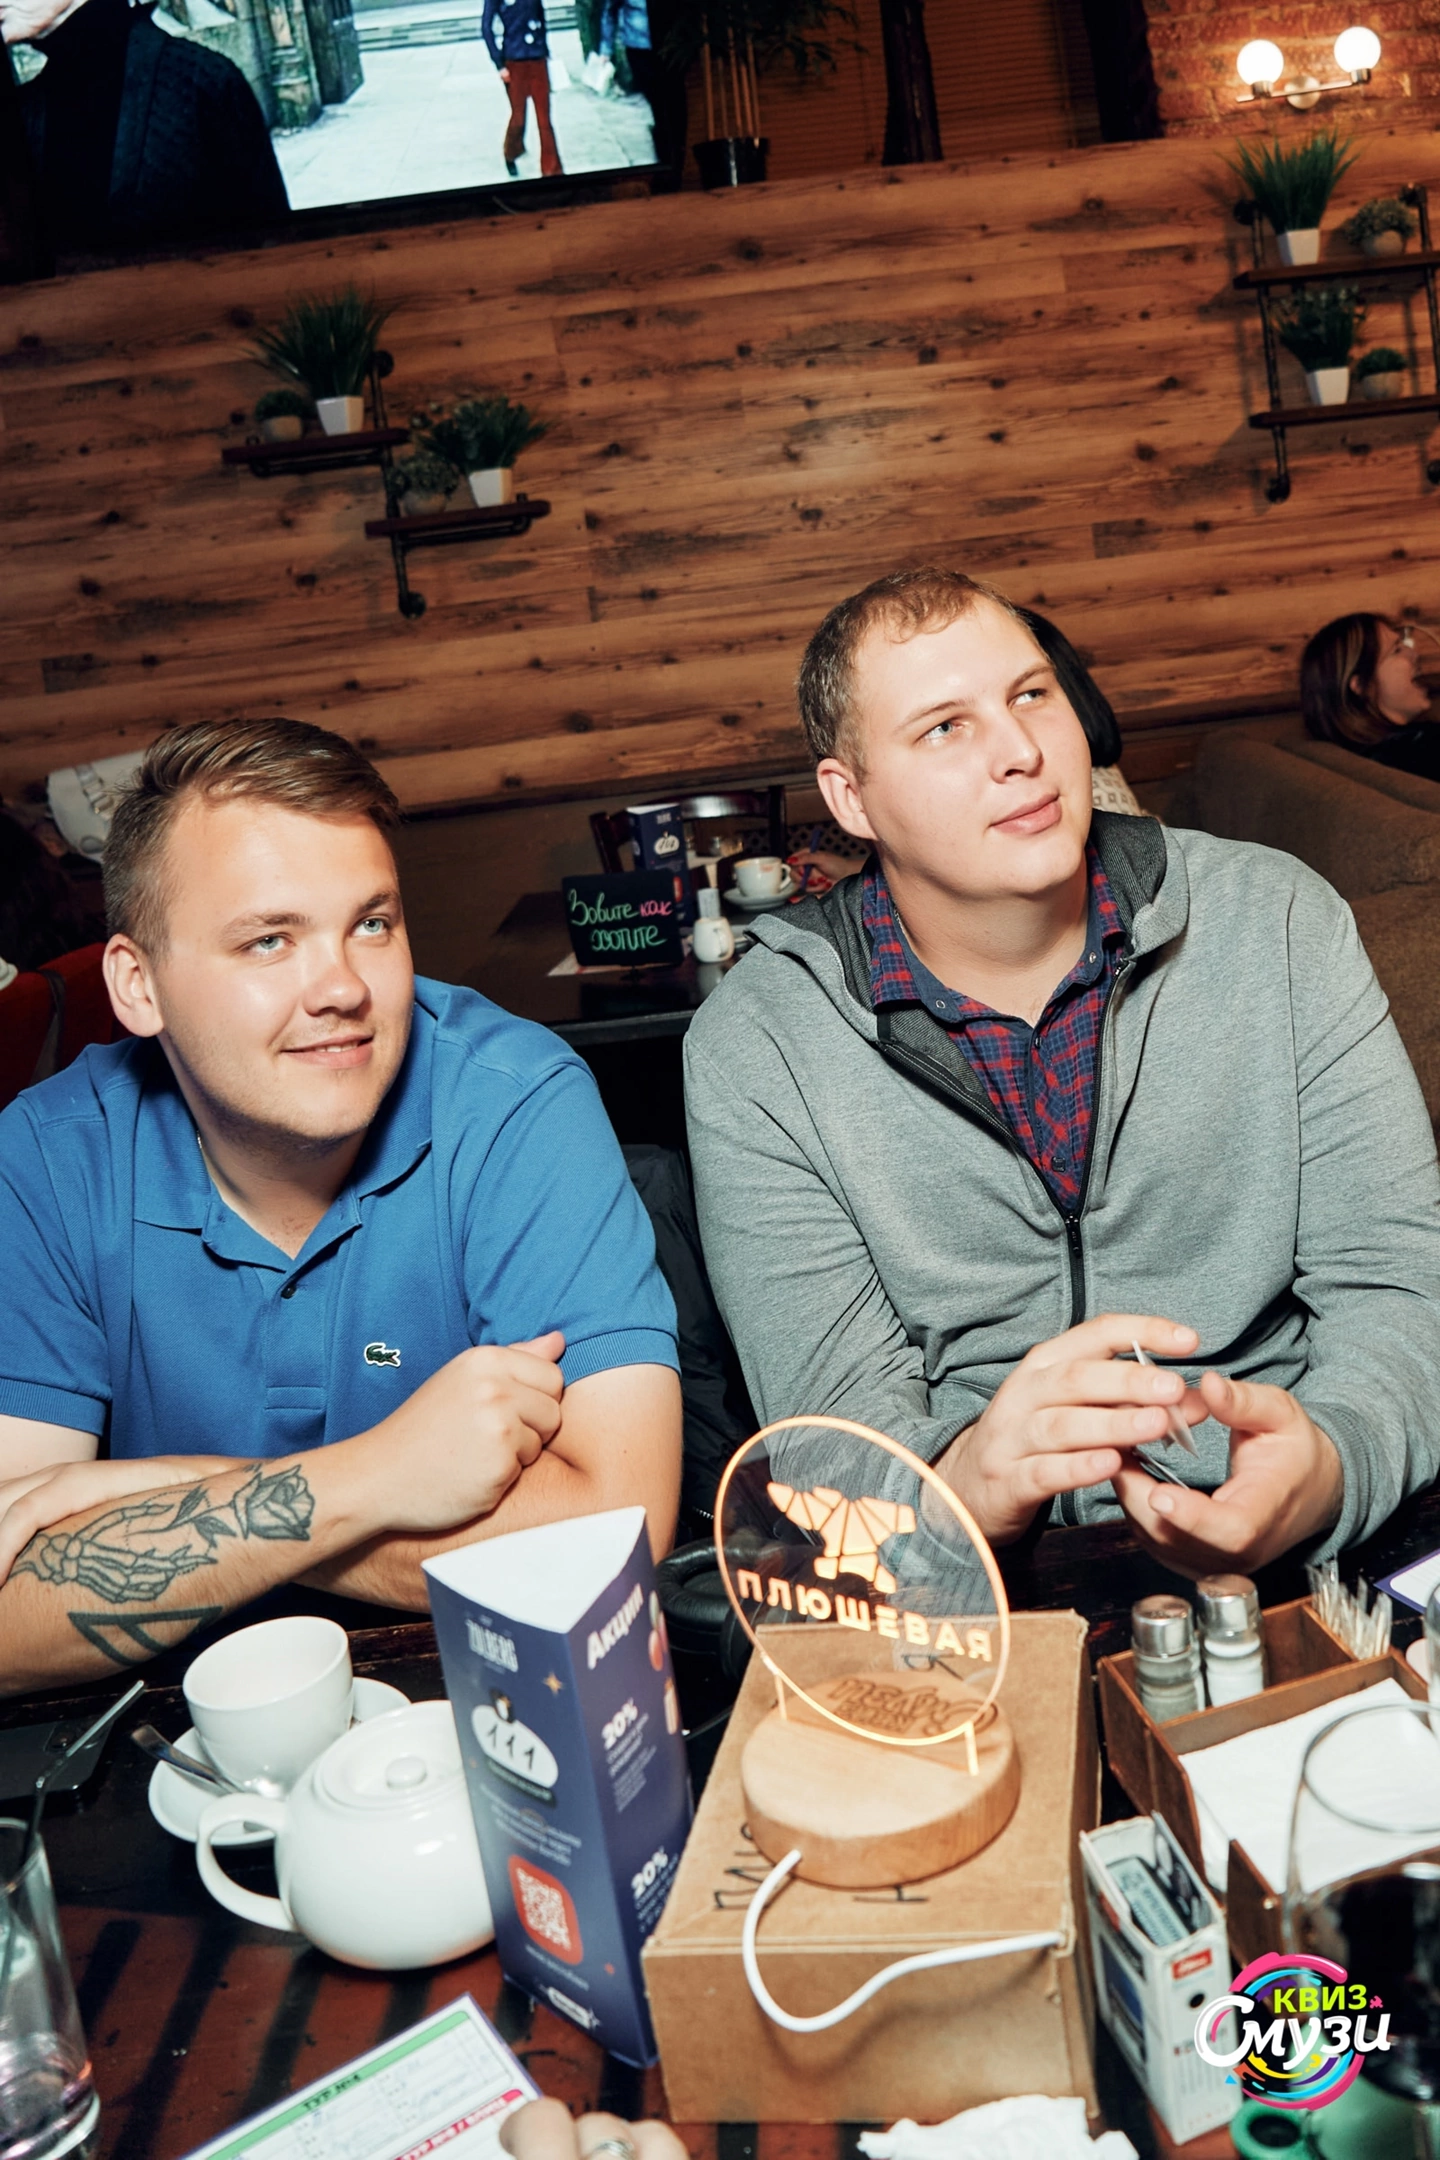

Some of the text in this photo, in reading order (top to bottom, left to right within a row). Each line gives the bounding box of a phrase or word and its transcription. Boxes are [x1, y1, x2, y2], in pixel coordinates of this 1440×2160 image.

[587, 1582, 644, 1670] Акции
[736, 1568, 993, 1663] ПЛЮШЕВАЯ
[602, 1697, 639, 1751] 20%
[631, 1845, 668, 1900] 20%
